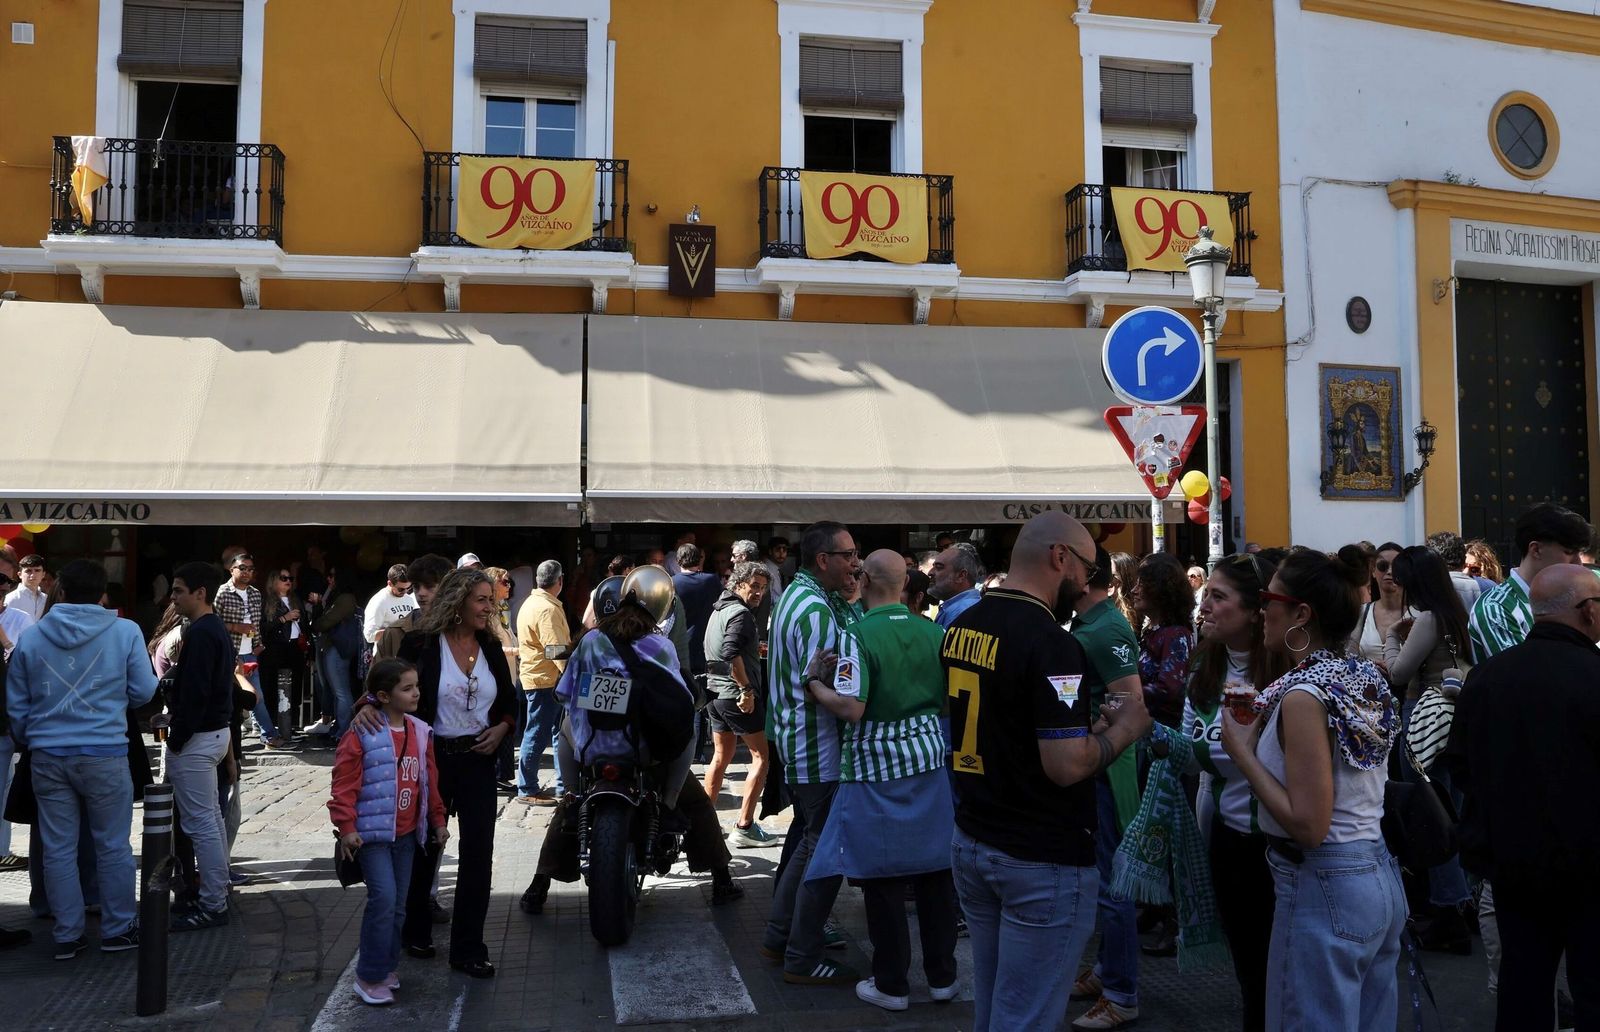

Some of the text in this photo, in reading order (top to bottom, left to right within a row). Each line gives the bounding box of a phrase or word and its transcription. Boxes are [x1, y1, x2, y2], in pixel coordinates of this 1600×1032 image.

[480, 165, 566, 239] 90
[821, 182, 900, 249] 90
[520, 218, 572, 230] VIZCAÍNO
[1134, 196, 1208, 261] 90
[1465, 224, 1502, 254] REGINA
[21, 500, 151, 521] VIZCAÍNO
[943, 626, 1000, 671] CANTONA
[593, 677, 627, 695] 7345
[594, 694, 620, 710] GYF
[948, 666, 985, 775] 7
[399, 788, 411, 811] 8
